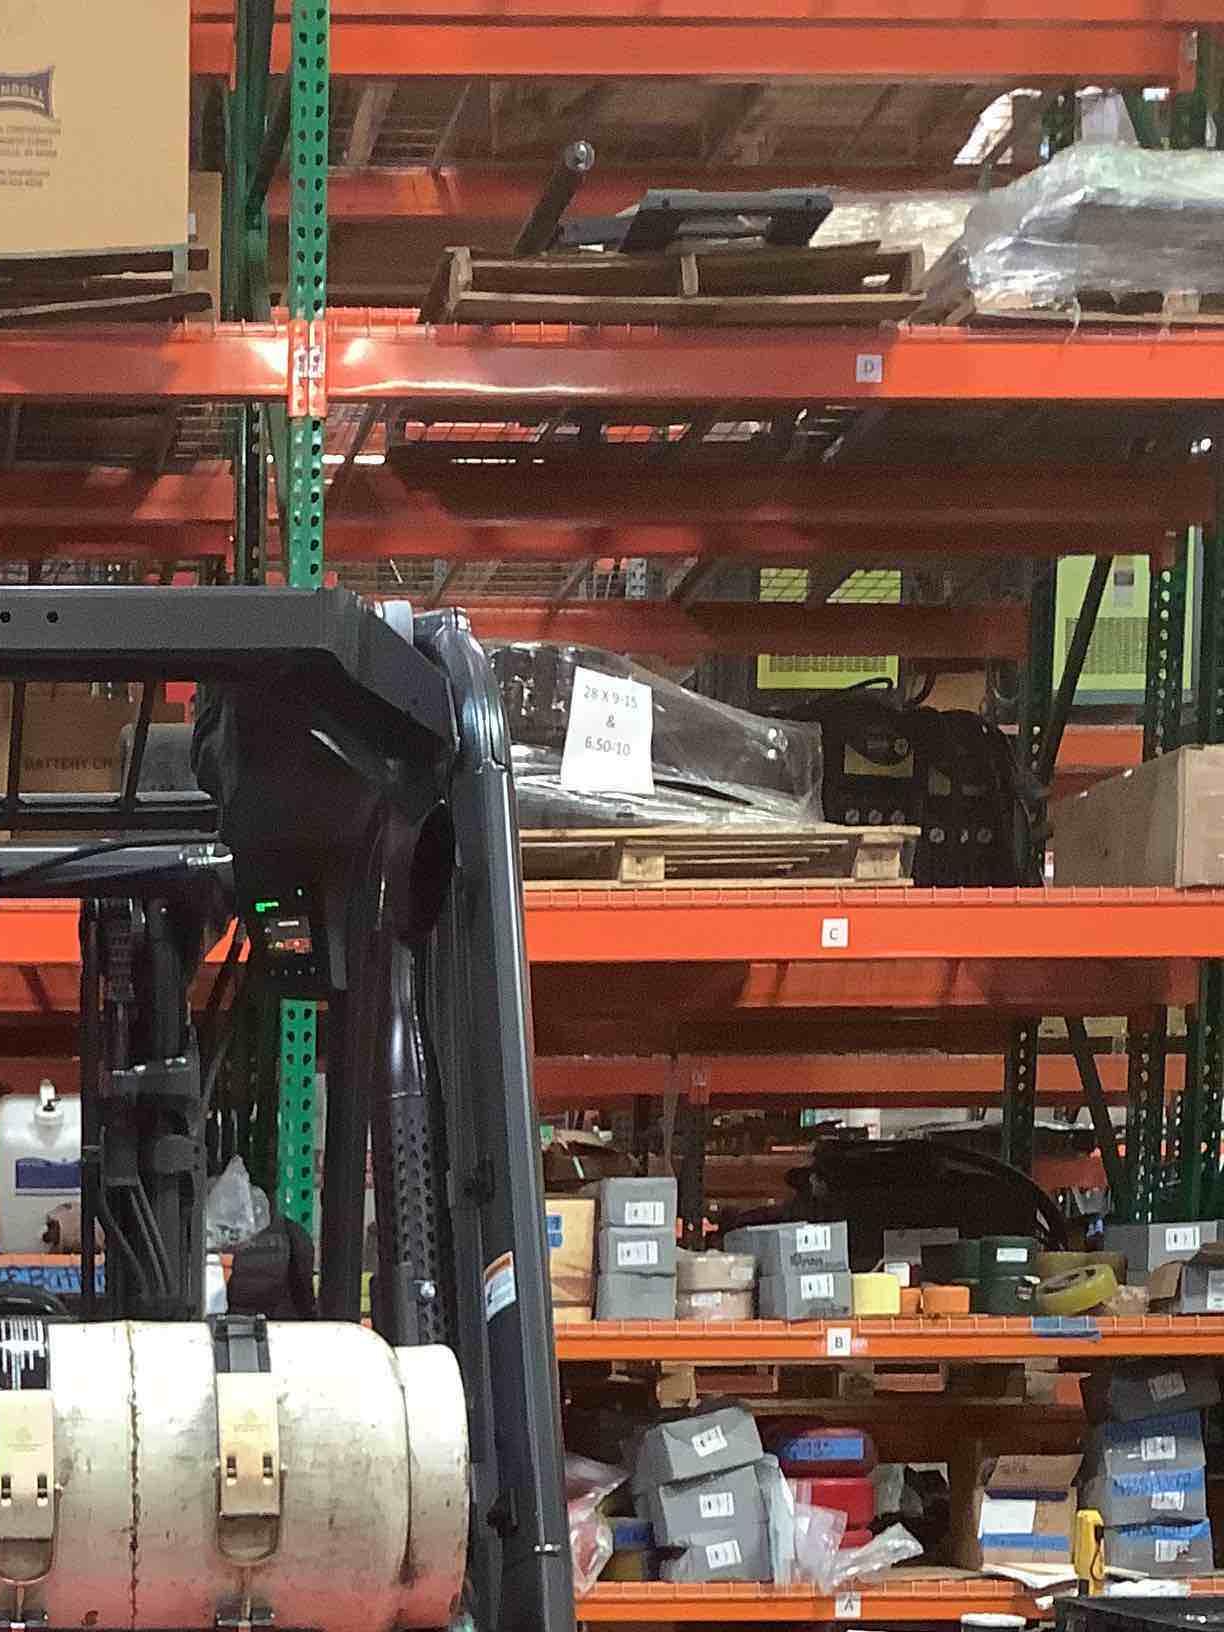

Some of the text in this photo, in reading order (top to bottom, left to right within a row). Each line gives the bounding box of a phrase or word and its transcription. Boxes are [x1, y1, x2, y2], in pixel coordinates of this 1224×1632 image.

[584, 684, 599, 699] 28
[606, 714, 616, 728] &
[829, 927, 841, 940] C
[844, 1598, 854, 1611] A
